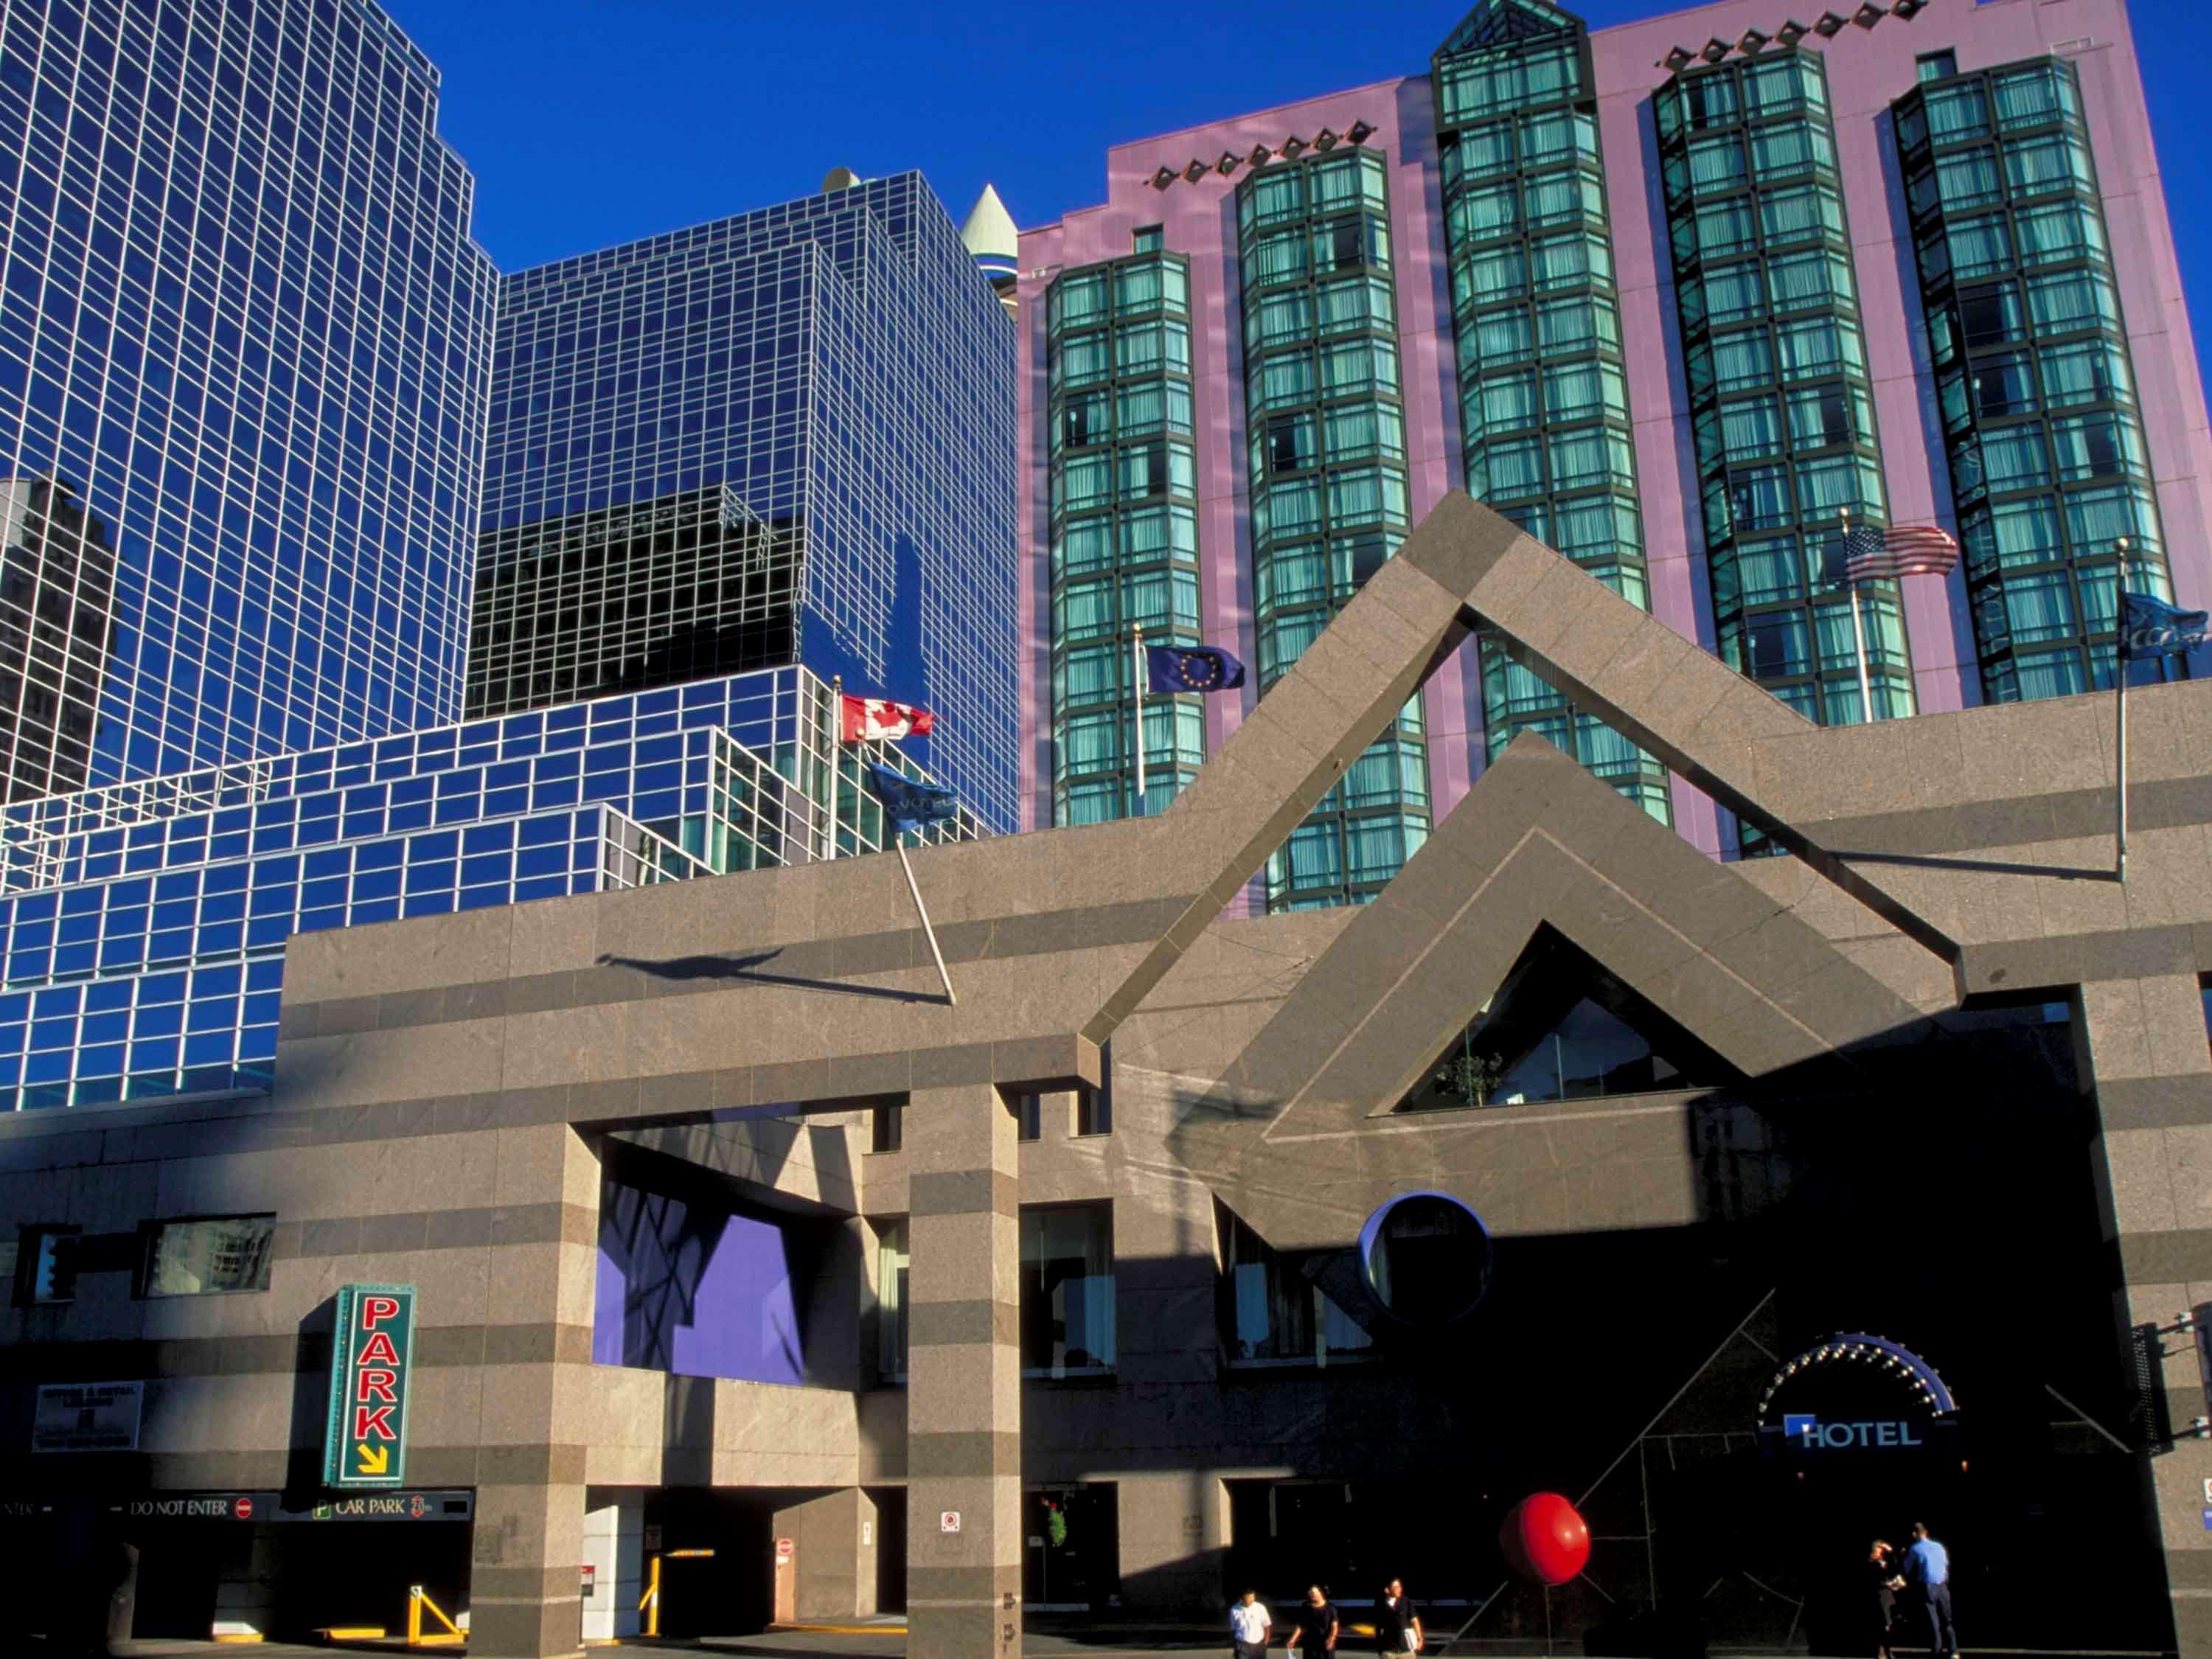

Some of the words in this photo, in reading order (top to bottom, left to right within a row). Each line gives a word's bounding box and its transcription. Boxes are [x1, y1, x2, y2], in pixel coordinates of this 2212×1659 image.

[355, 1297, 400, 1440] PARK
[1801, 1422, 1923, 1447] HOTEL
[131, 1501, 153, 1516] DO
[156, 1500, 185, 1516] NOT
[187, 1500, 227, 1515] ENTER
[335, 1499, 364, 1514] CAR
[369, 1498, 405, 1514] PARK
